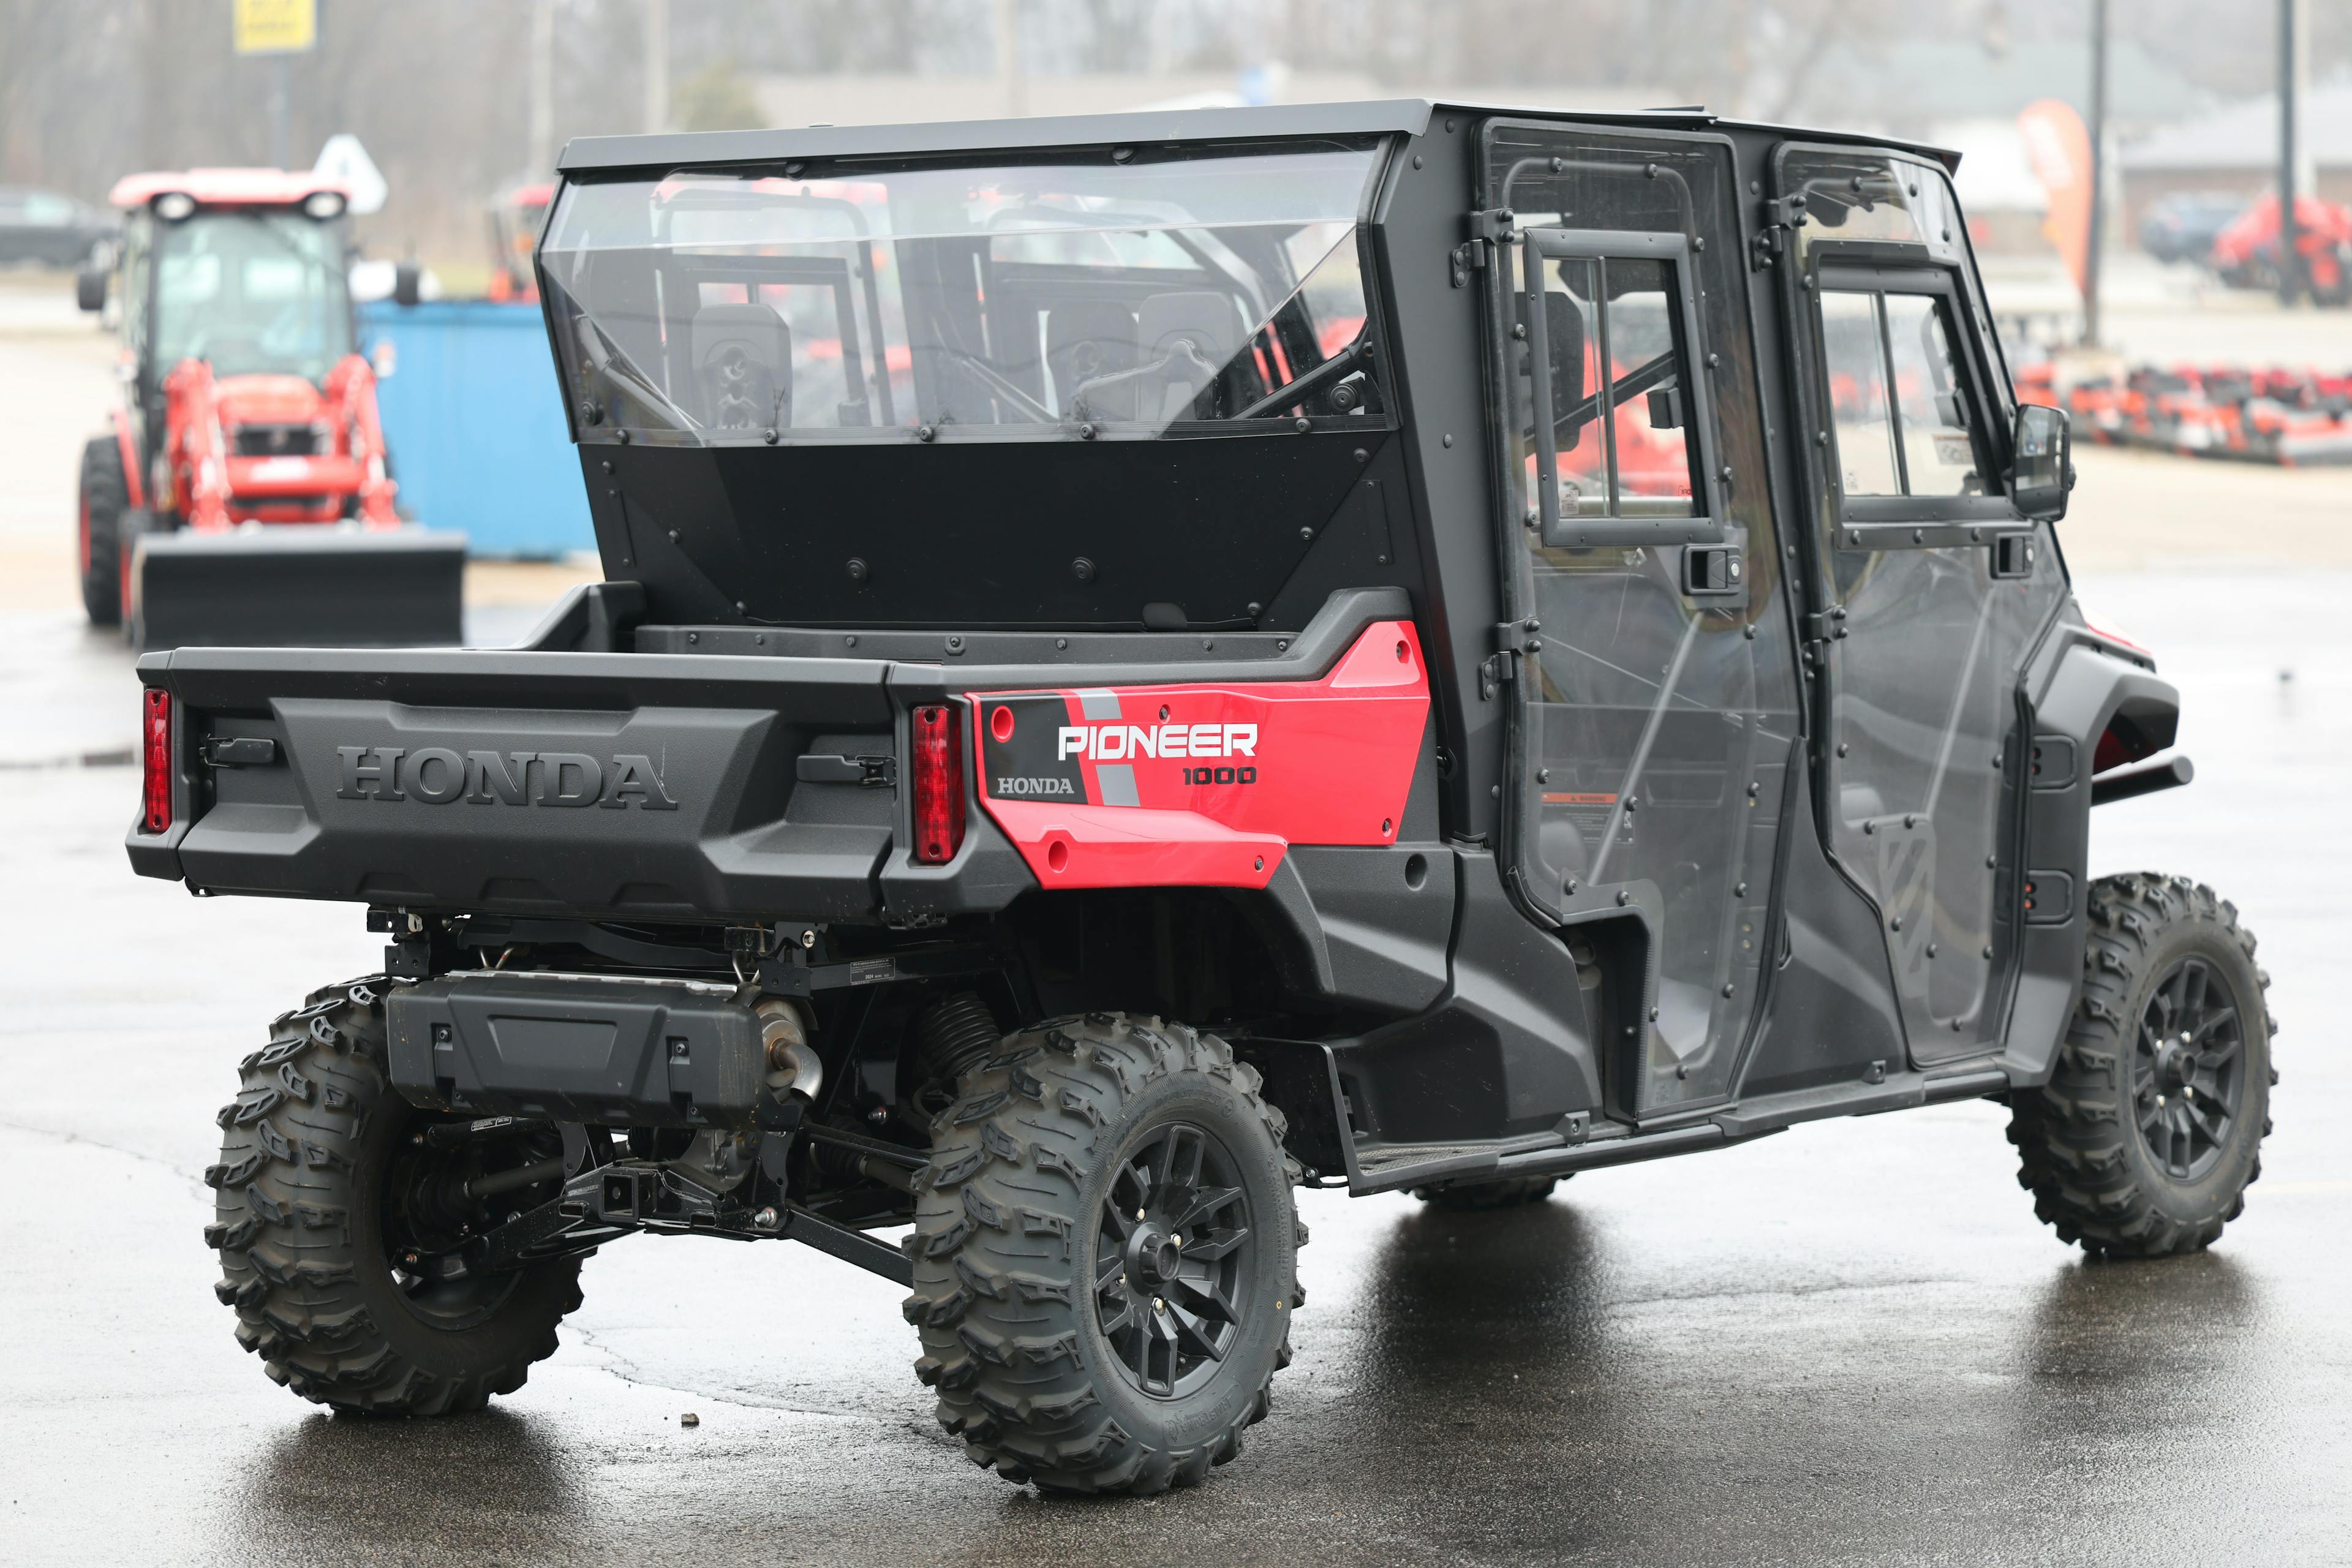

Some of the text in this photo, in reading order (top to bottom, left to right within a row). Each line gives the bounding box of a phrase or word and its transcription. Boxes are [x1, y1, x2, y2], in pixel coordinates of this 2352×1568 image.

[1058, 723, 1258, 760] PIONEER
[336, 746, 678, 810] HONDA
[998, 777, 1074, 794] HONDA
[1183, 767, 1257, 785] 1000
